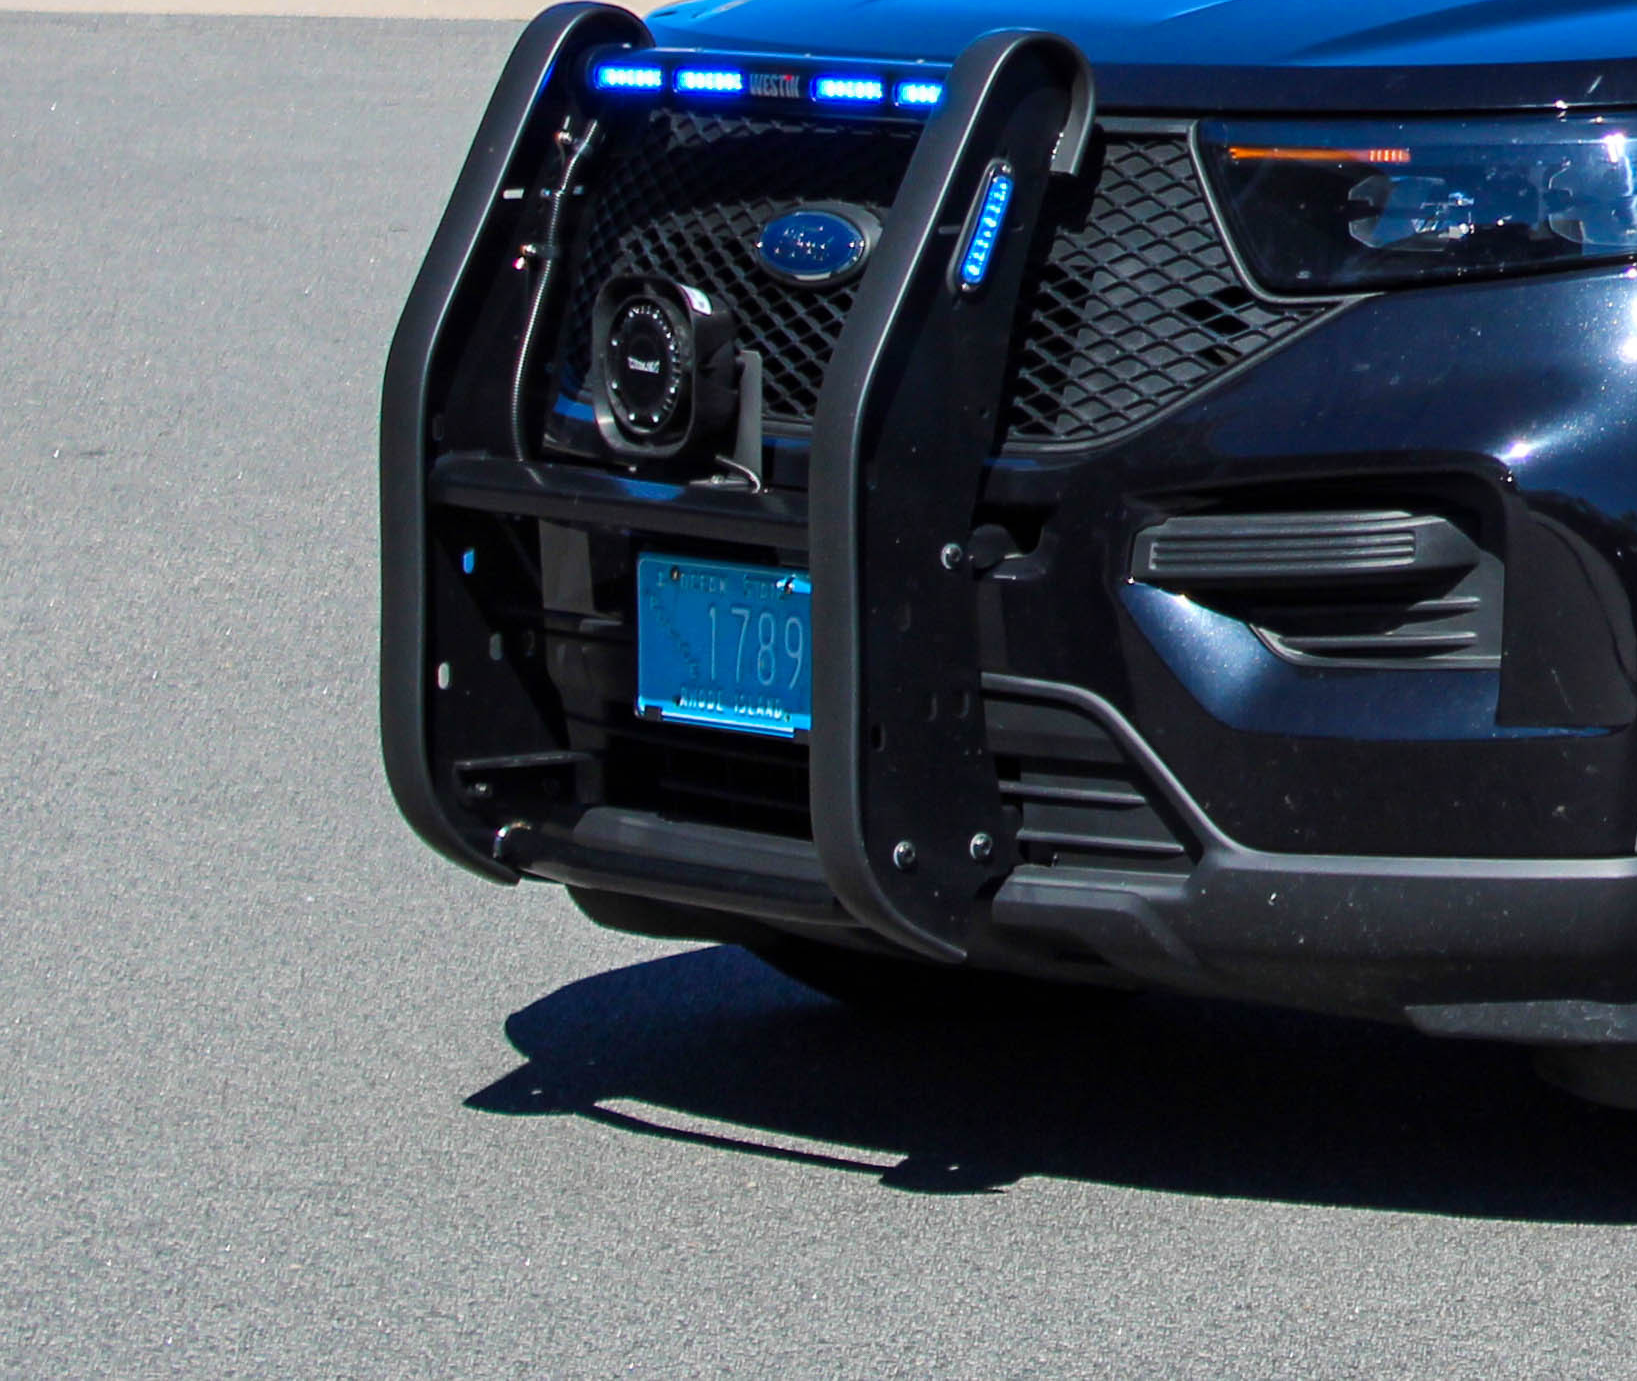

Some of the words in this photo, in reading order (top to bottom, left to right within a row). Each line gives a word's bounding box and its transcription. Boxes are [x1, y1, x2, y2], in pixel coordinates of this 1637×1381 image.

[708, 605, 805, 692] 1789
[679, 685, 725, 712] RHODE
[733, 692, 783, 720] ISLAND
